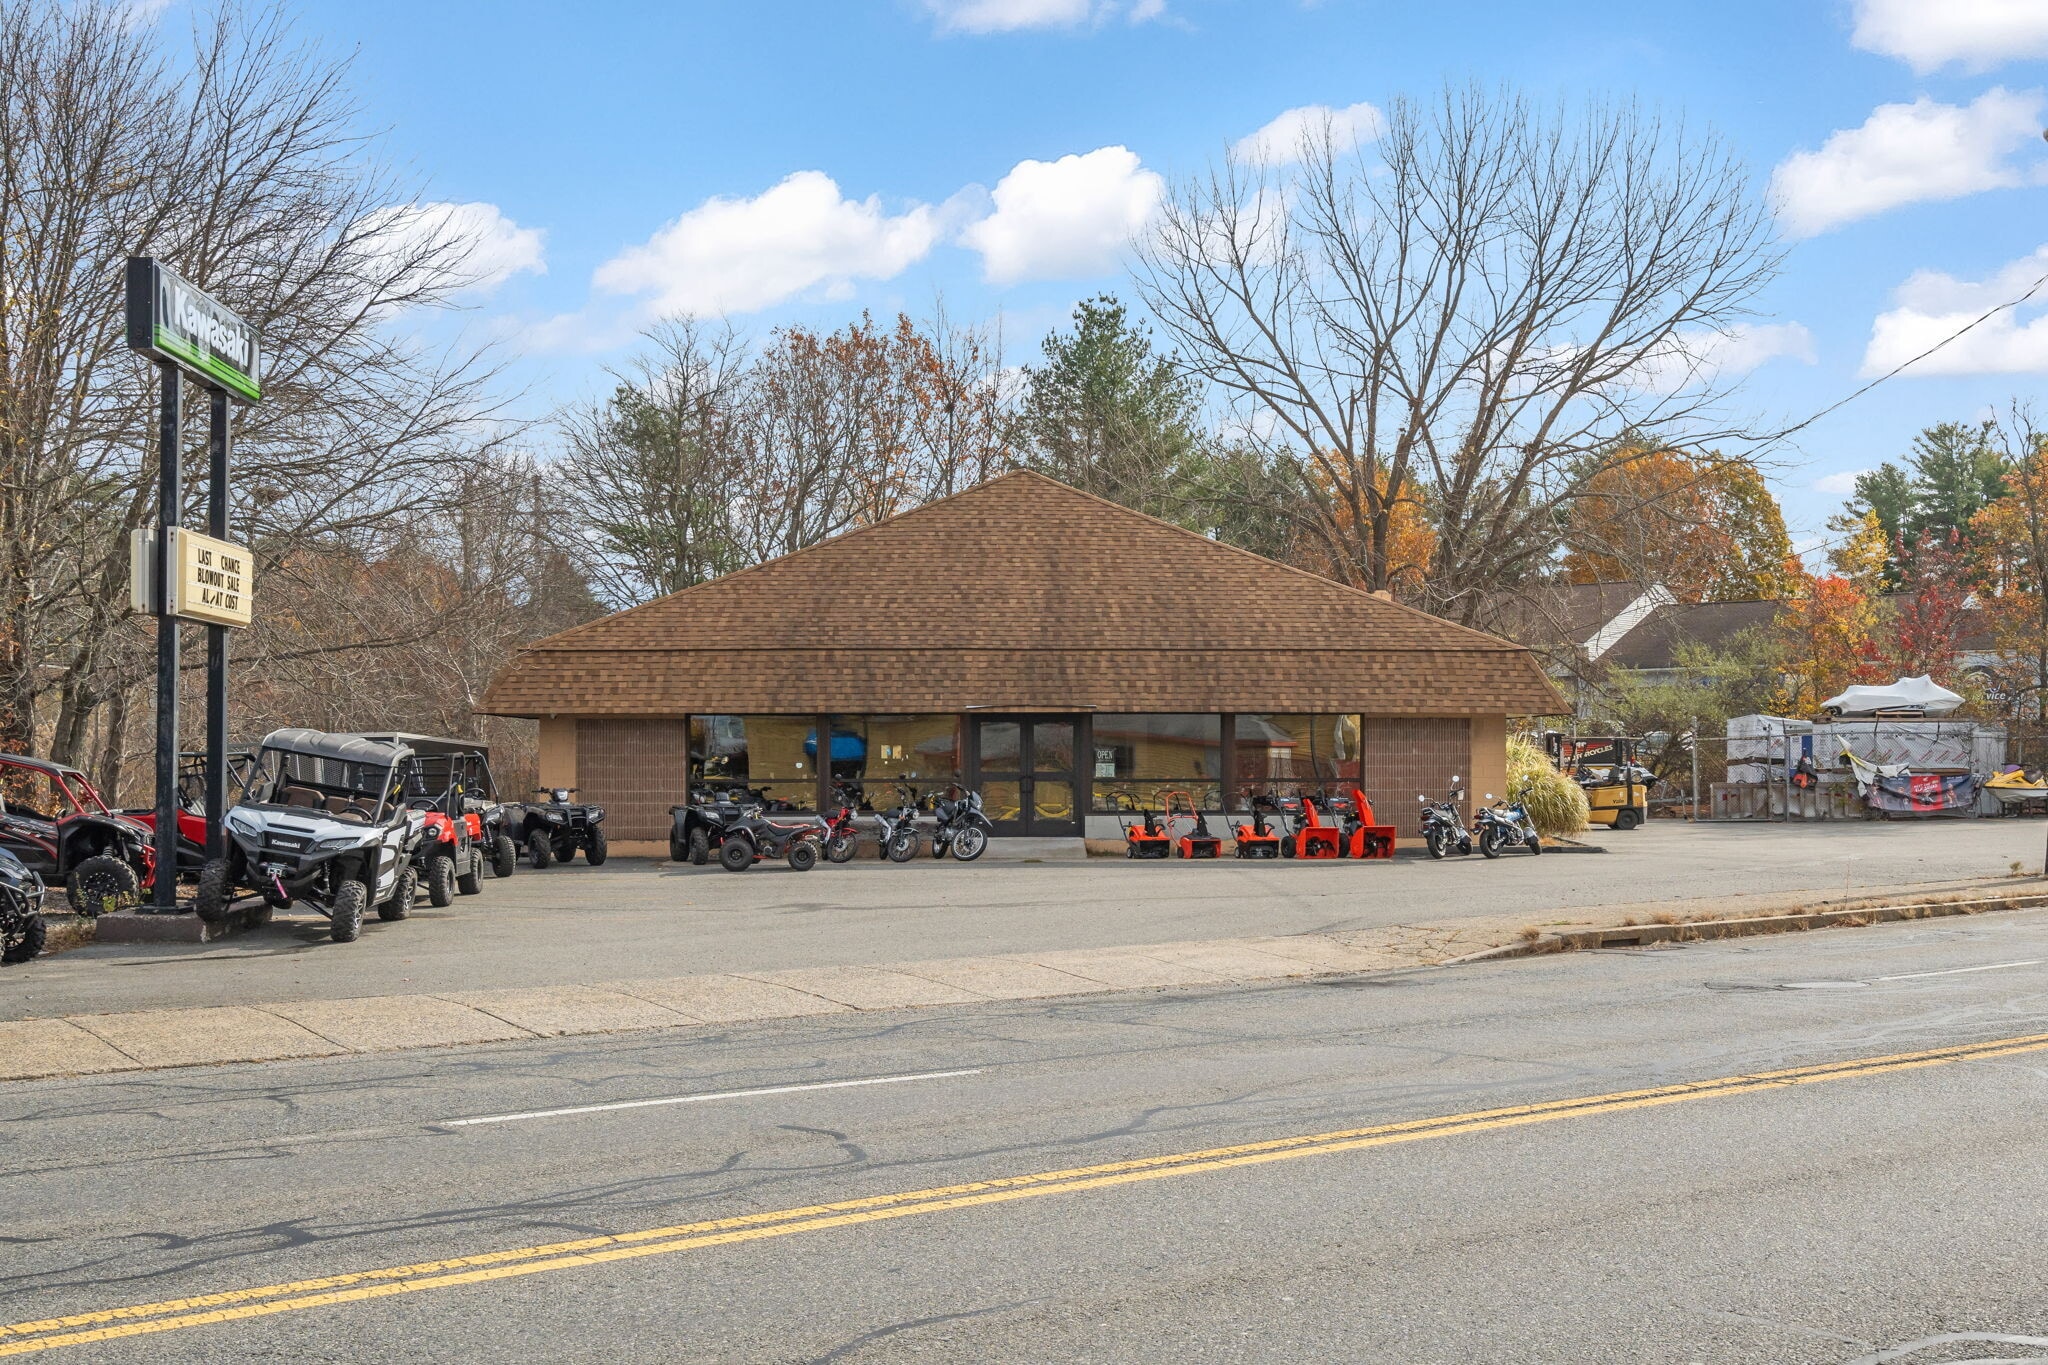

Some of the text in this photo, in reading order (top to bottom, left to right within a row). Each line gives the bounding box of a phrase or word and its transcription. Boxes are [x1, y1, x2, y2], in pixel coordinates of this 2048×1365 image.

[174, 285, 250, 367] Kawasaki
[198, 548, 240, 575] LAST CHANCE
[198, 567, 240, 593] BLOWOUT SALE
[215, 592, 223, 607] AT
[225, 594, 238, 610] COST
[1097, 750, 1113, 759] OPEN
